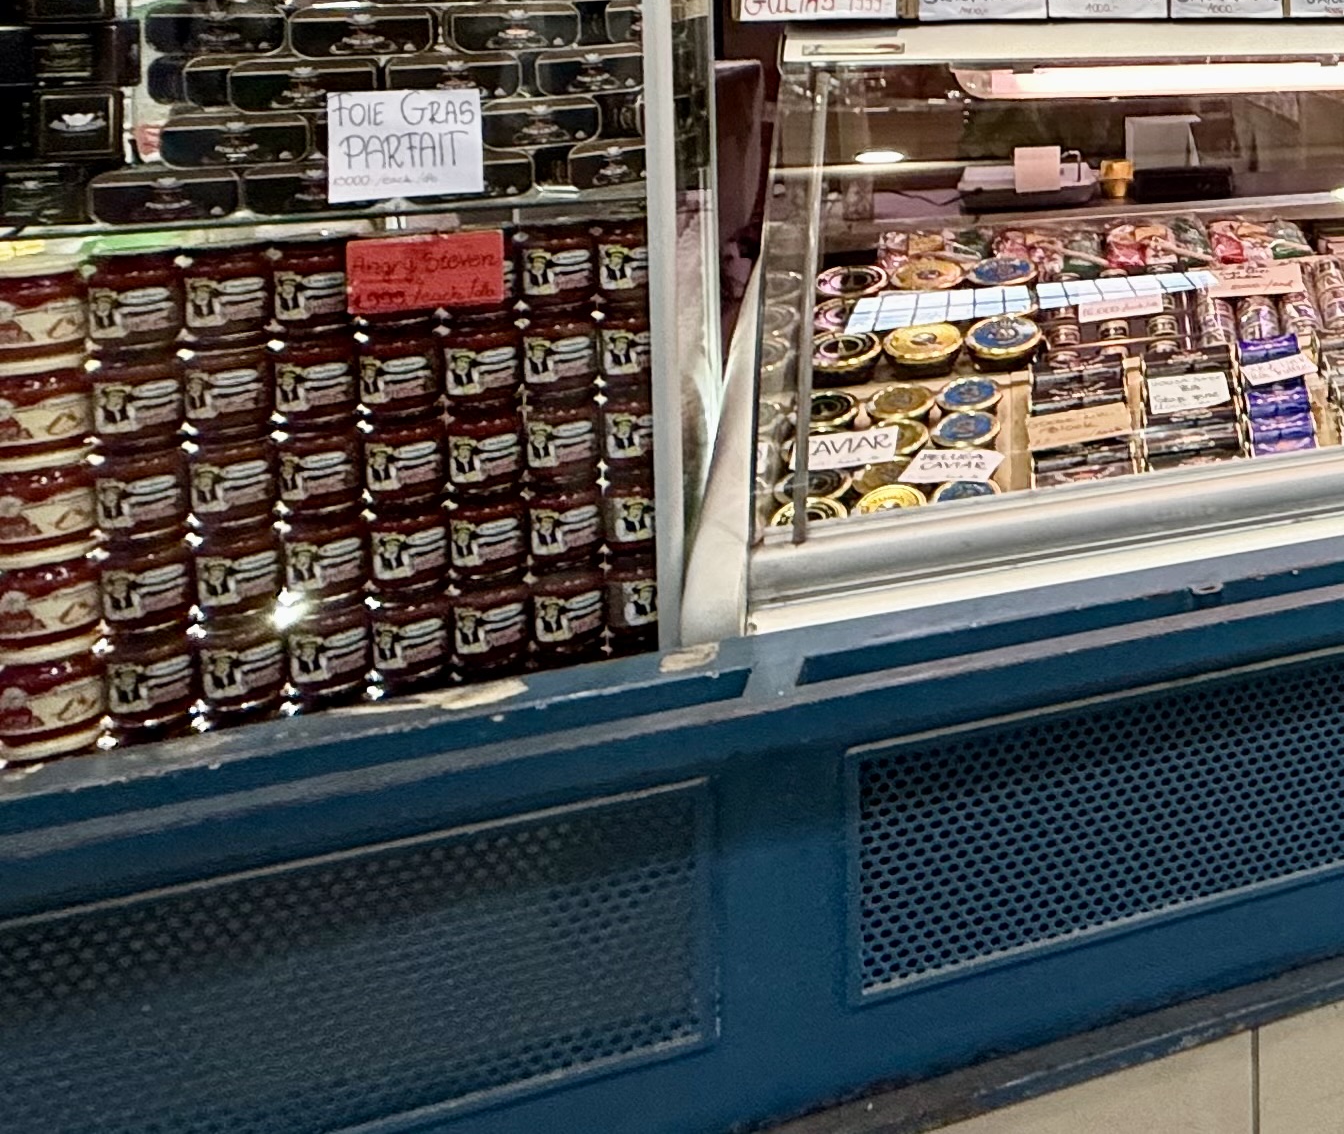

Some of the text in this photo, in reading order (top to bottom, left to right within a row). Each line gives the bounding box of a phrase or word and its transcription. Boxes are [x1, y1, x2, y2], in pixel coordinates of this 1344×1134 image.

[328, 91, 475, 127] FOIE GRAS
[338, 130, 469, 170] PARFAIT
